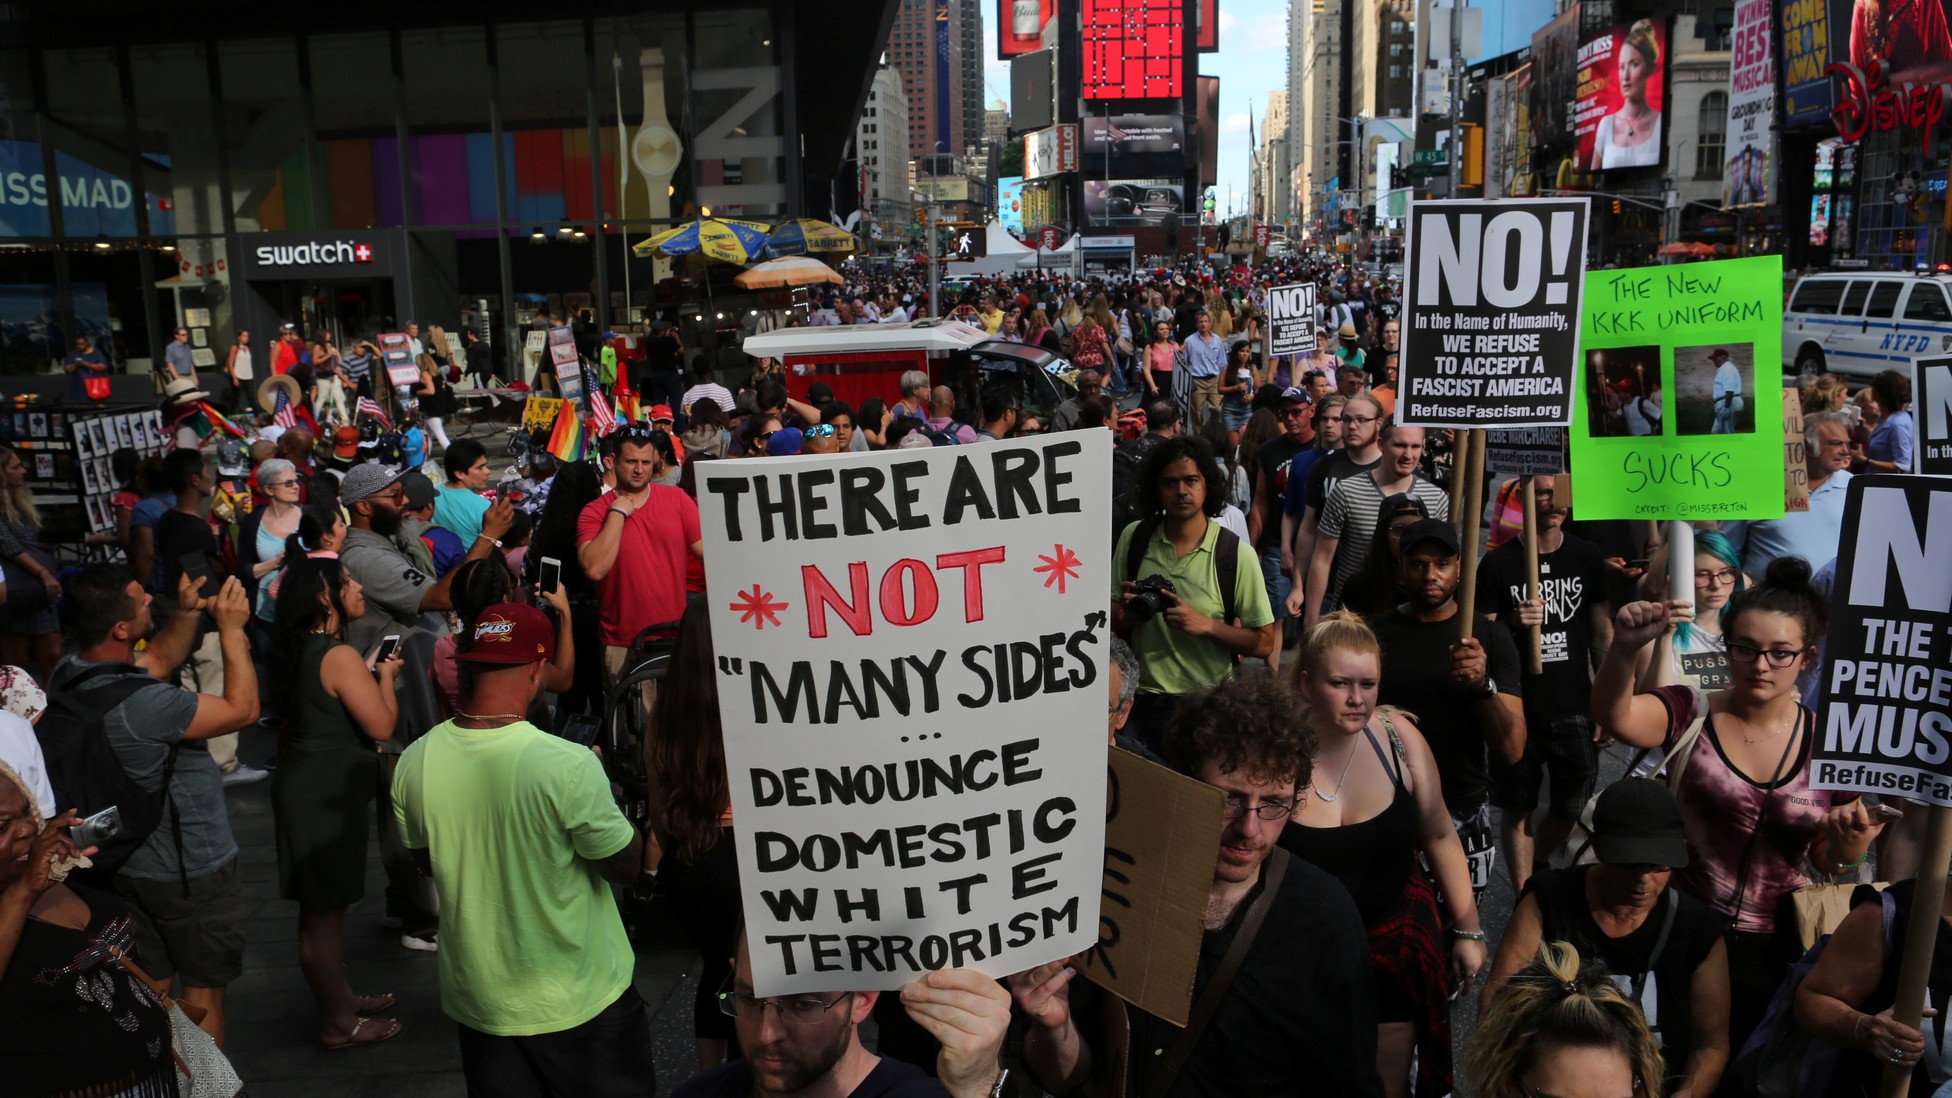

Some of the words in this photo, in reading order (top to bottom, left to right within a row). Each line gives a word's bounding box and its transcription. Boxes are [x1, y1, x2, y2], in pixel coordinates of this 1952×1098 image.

[1783, 0, 1825, 31] COME
[1786, 50, 1827, 87] AWAY
[1426, 151, 1437, 161] 45
[60, 176, 150, 210] MAD
[257, 239, 354, 266] swatch
[808, 240, 850, 249] SABRETT
[1417, 210, 1575, 308] NO!
[1609, 274, 1652, 302] THE
[1666, 272, 1722, 299] NEW
[1272, 286, 1313, 319] NO!
[1415, 313, 1427, 329] In
[1430, 313, 1451, 329] the
[1454, 313, 1490, 330] Name
[1493, 312, 1507, 329] of
[1508, 312, 1568, 331] Humanity,
[1592, 310, 1646, 334] KKK
[1657, 300, 1764, 330] UNIFORM
[1286, 330, 1304, 338] ACCEPT
[1443, 335, 1471, 353] WE
[1475, 334, 1540, 353] REFUSE
[1880, 333, 1931, 353] NYPD
[1435, 357, 1457, 374] TO
[1461, 356, 1530, 375] ACCEPT
[1532, 356, 1545, 373] A
[1412, 378, 1483, 397] FASCIST
[1486, 377, 1563, 396] AMERICA
[1411, 404, 1561, 418] RefuseFascism.org
[1784, 442, 1805, 464] TO
[1927, 445, 1939, 459] In
[1623, 451, 1732, 493] SUCKS
[1790, 469, 1807, 487] TO
[706, 459, 931, 542] THERE
[943, 440, 1082, 526] ARE
[1635, 504, 1670, 514] CREDIT:
[801, 545, 1006, 639] NOT
[1540, 631, 1567, 645] NO!
[1862, 618, 1934, 659] THE
[1684, 655, 1727, 669] PUSS
[750, 738, 1043, 807] DENOUNCE
[754, 796, 1077, 872] DOMESTIC
[760, 852, 1063, 923] WHITE
[765, 896, 1080, 976] TERRORISM
